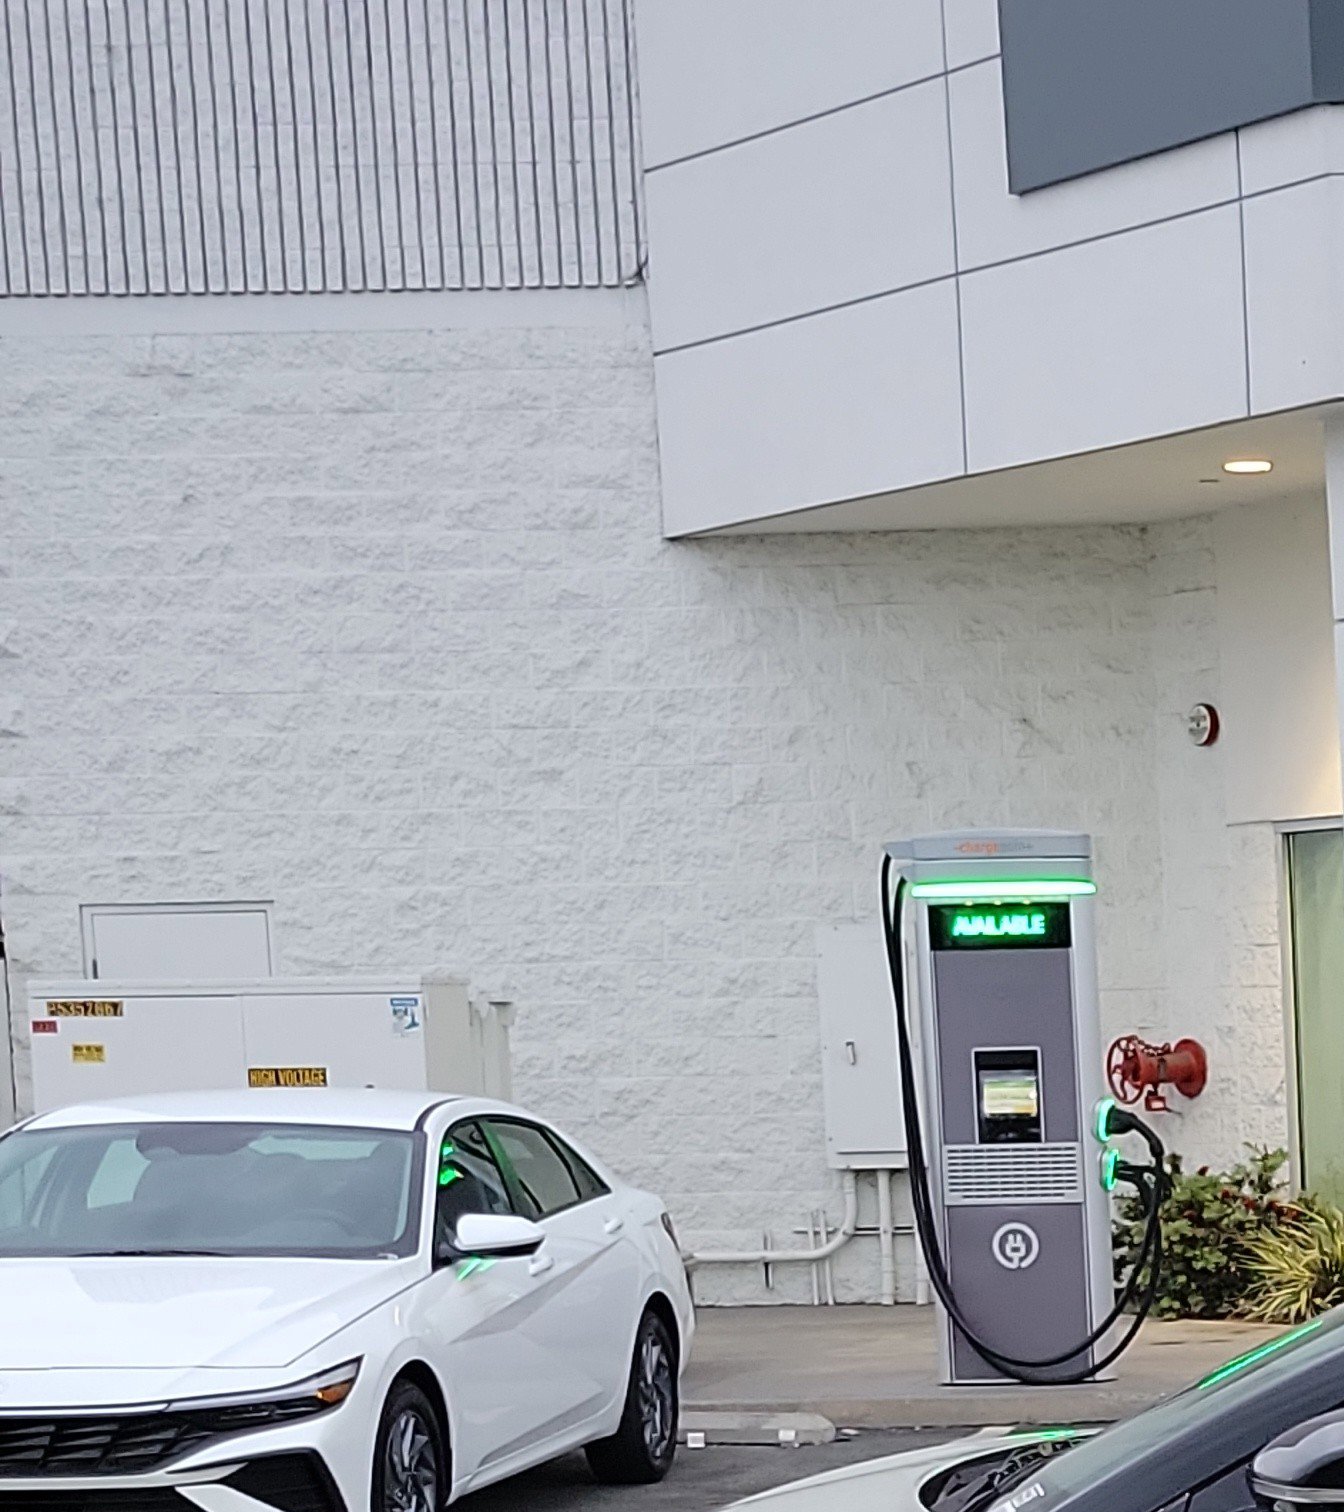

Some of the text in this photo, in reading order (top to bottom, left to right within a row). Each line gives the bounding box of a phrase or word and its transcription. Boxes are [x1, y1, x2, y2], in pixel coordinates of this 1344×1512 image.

[952, 914, 1045, 936] AVAILABLE
[250, 1069, 325, 1086] HIGH VOLTAGE
